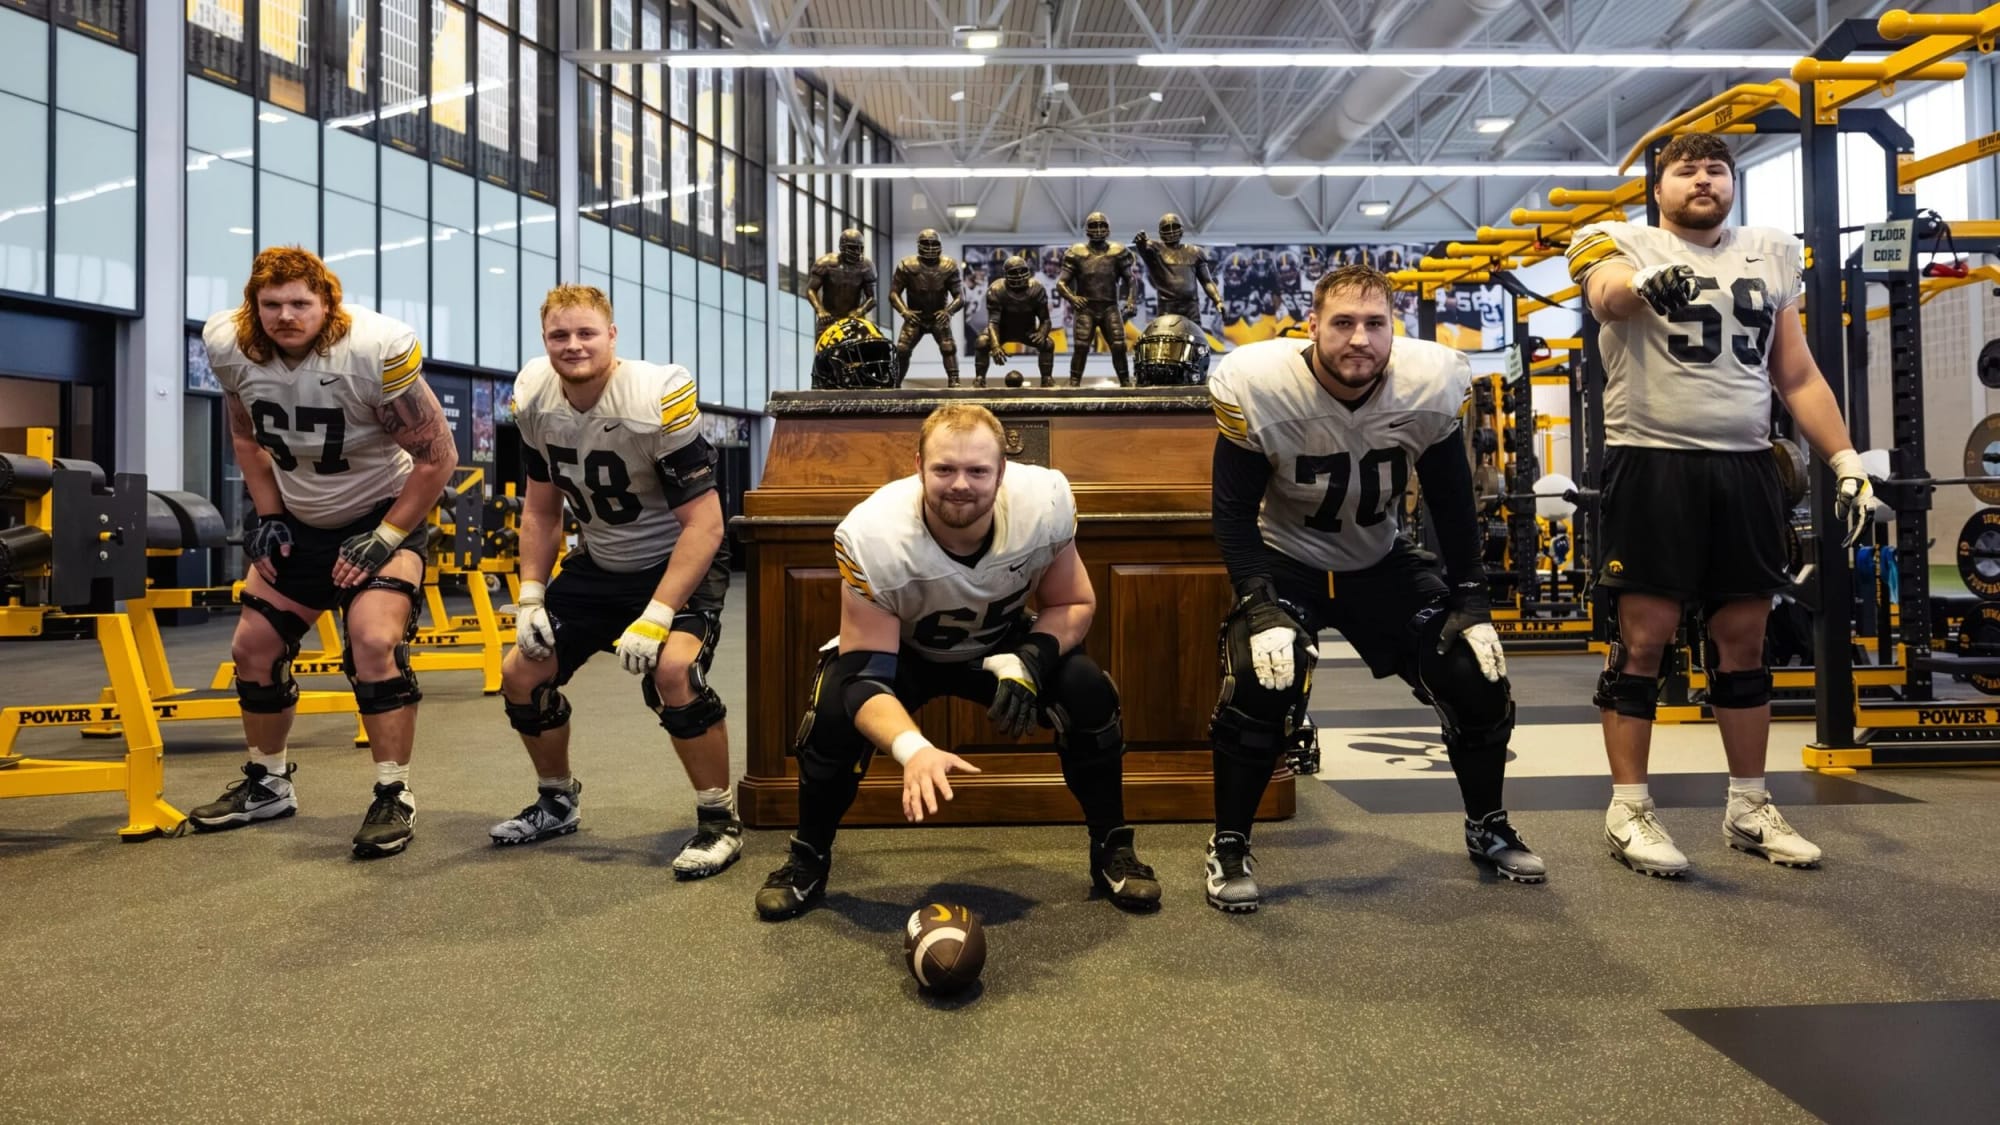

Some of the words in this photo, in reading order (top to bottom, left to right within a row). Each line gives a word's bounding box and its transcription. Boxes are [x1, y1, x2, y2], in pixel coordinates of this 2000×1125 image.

[1870, 227, 1906, 242] FLOOR
[1874, 248, 1902, 262] CORE
[1668, 276, 1774, 365] 59
[251, 399, 350, 475] 67
[546, 444, 643, 525] 58
[1295, 445, 1408, 533] 70
[912, 579, 1032, 650] 65
[1492, 622, 1517, 632] WER
[1521, 622, 1563, 632] LIFT
[414, 635, 460, 645] LIFT
[19, 708, 92, 725] POWER
[101, 705, 178, 722] LT
[1918, 709, 1987, 725] POWER
